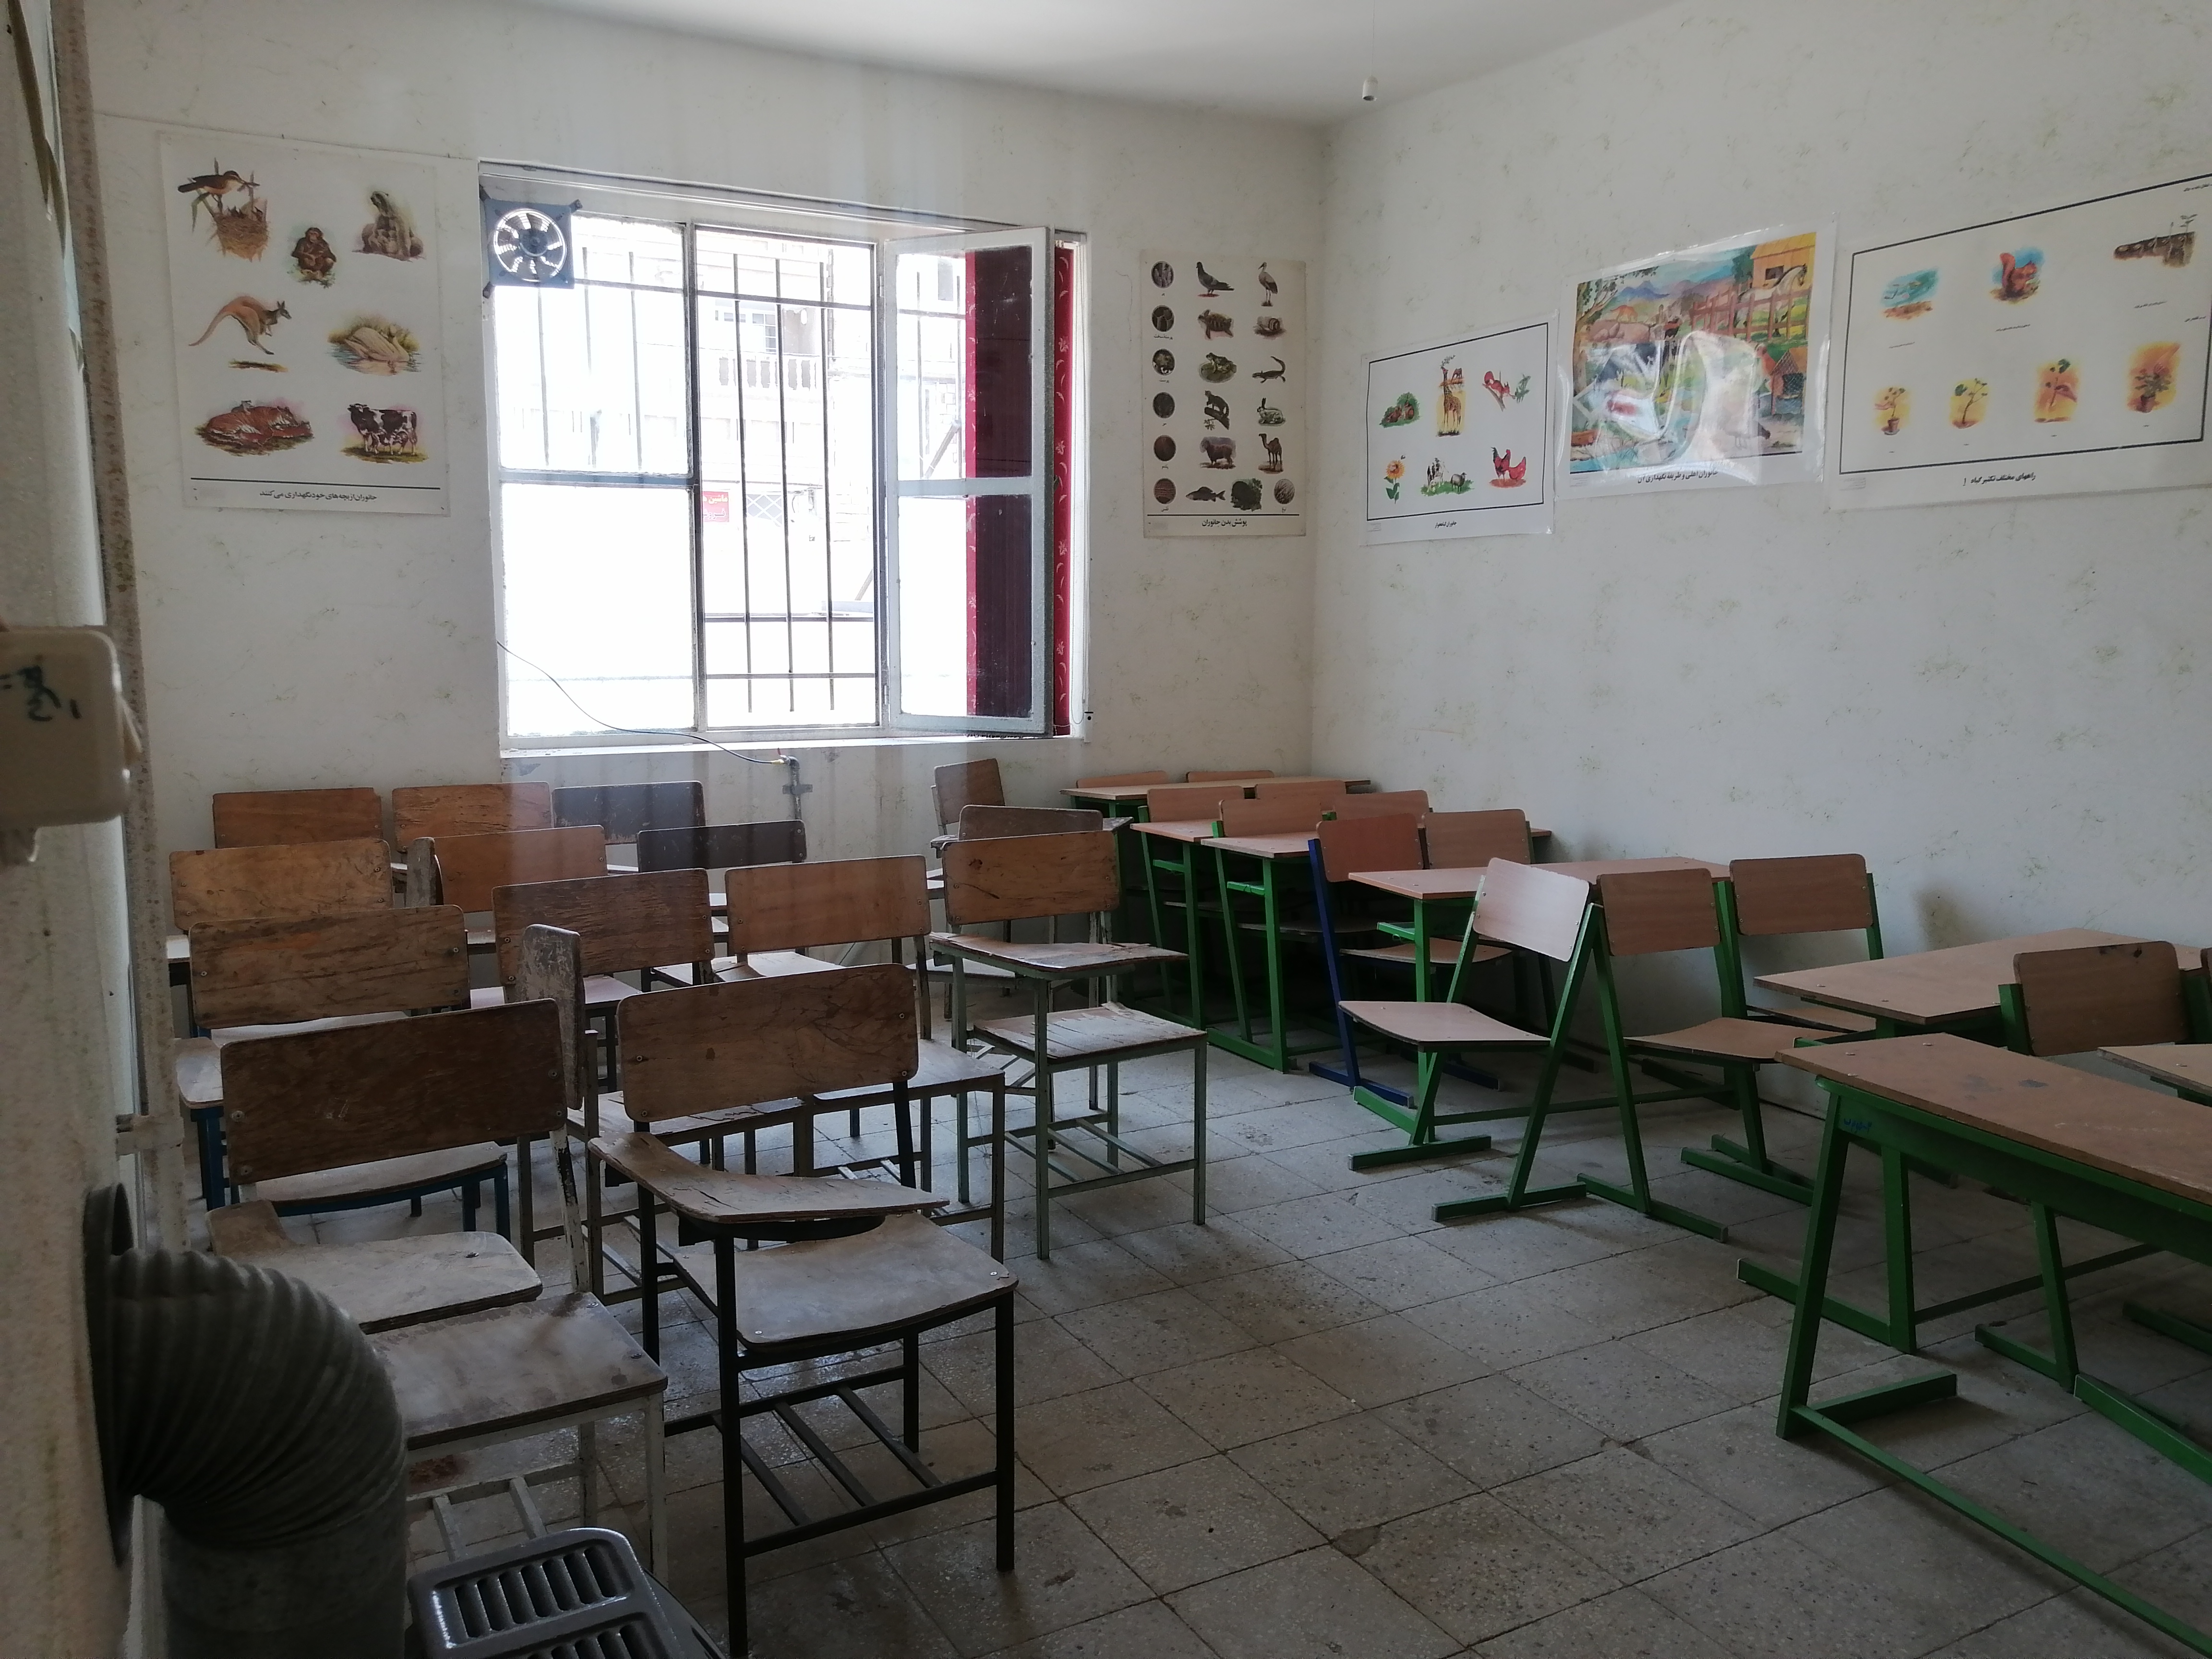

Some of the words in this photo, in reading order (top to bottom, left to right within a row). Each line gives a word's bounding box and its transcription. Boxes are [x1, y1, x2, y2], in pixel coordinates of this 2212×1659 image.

[1685, 470, 1698, 479] اهلی
[708, 494, 728, 504] ماشین
[1202, 519, 1220, 527] جانوران
[1232, 518, 1248, 527] پوشش
